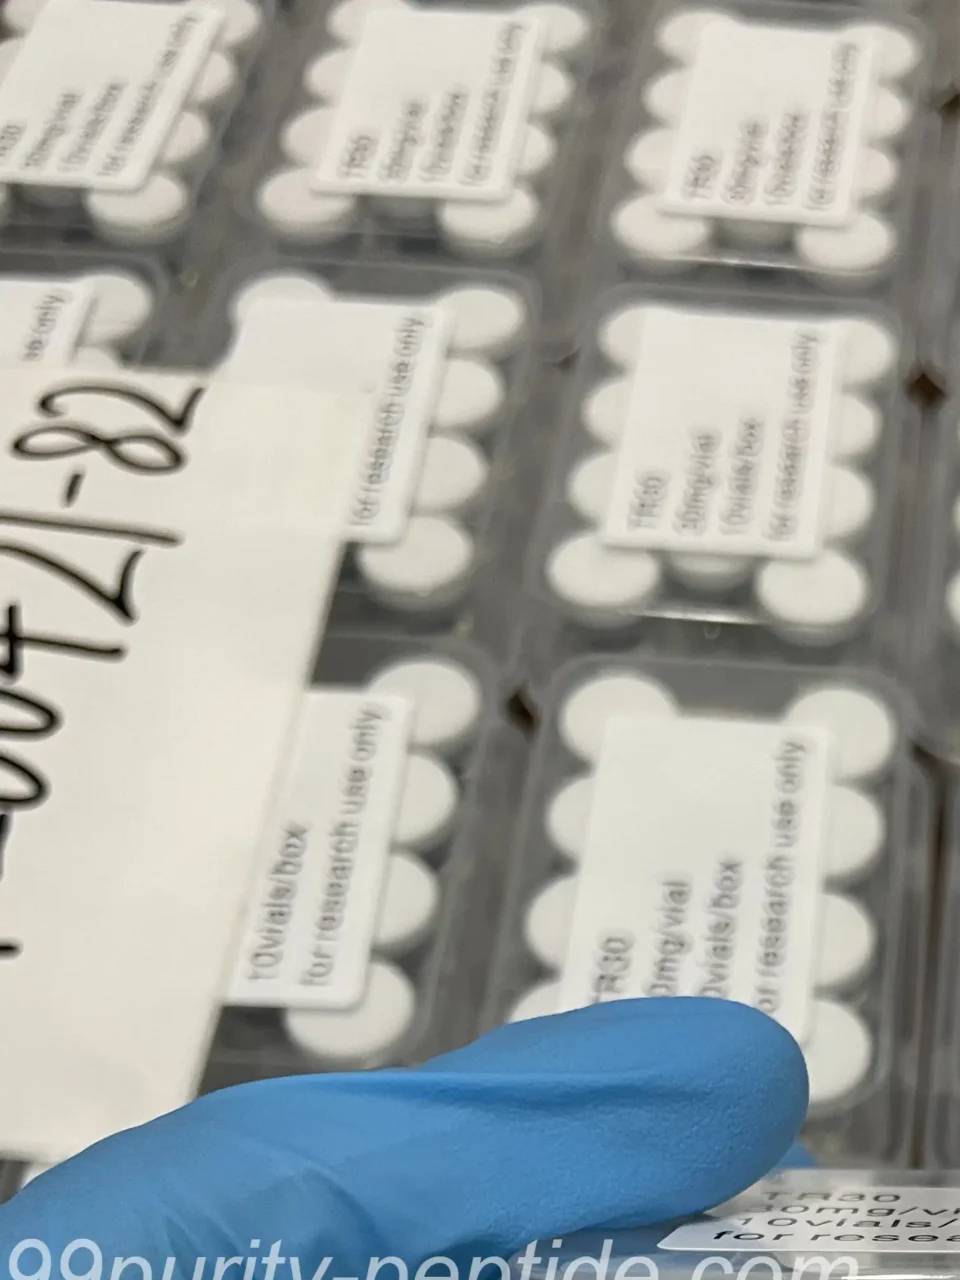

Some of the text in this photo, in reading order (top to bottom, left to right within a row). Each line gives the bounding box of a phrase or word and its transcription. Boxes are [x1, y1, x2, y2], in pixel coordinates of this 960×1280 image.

[756, 987, 777, 1013] or
[775, 739, 809, 795] only
[588, 936, 630, 1003] R30
[713, 1229, 794, 1242] for
